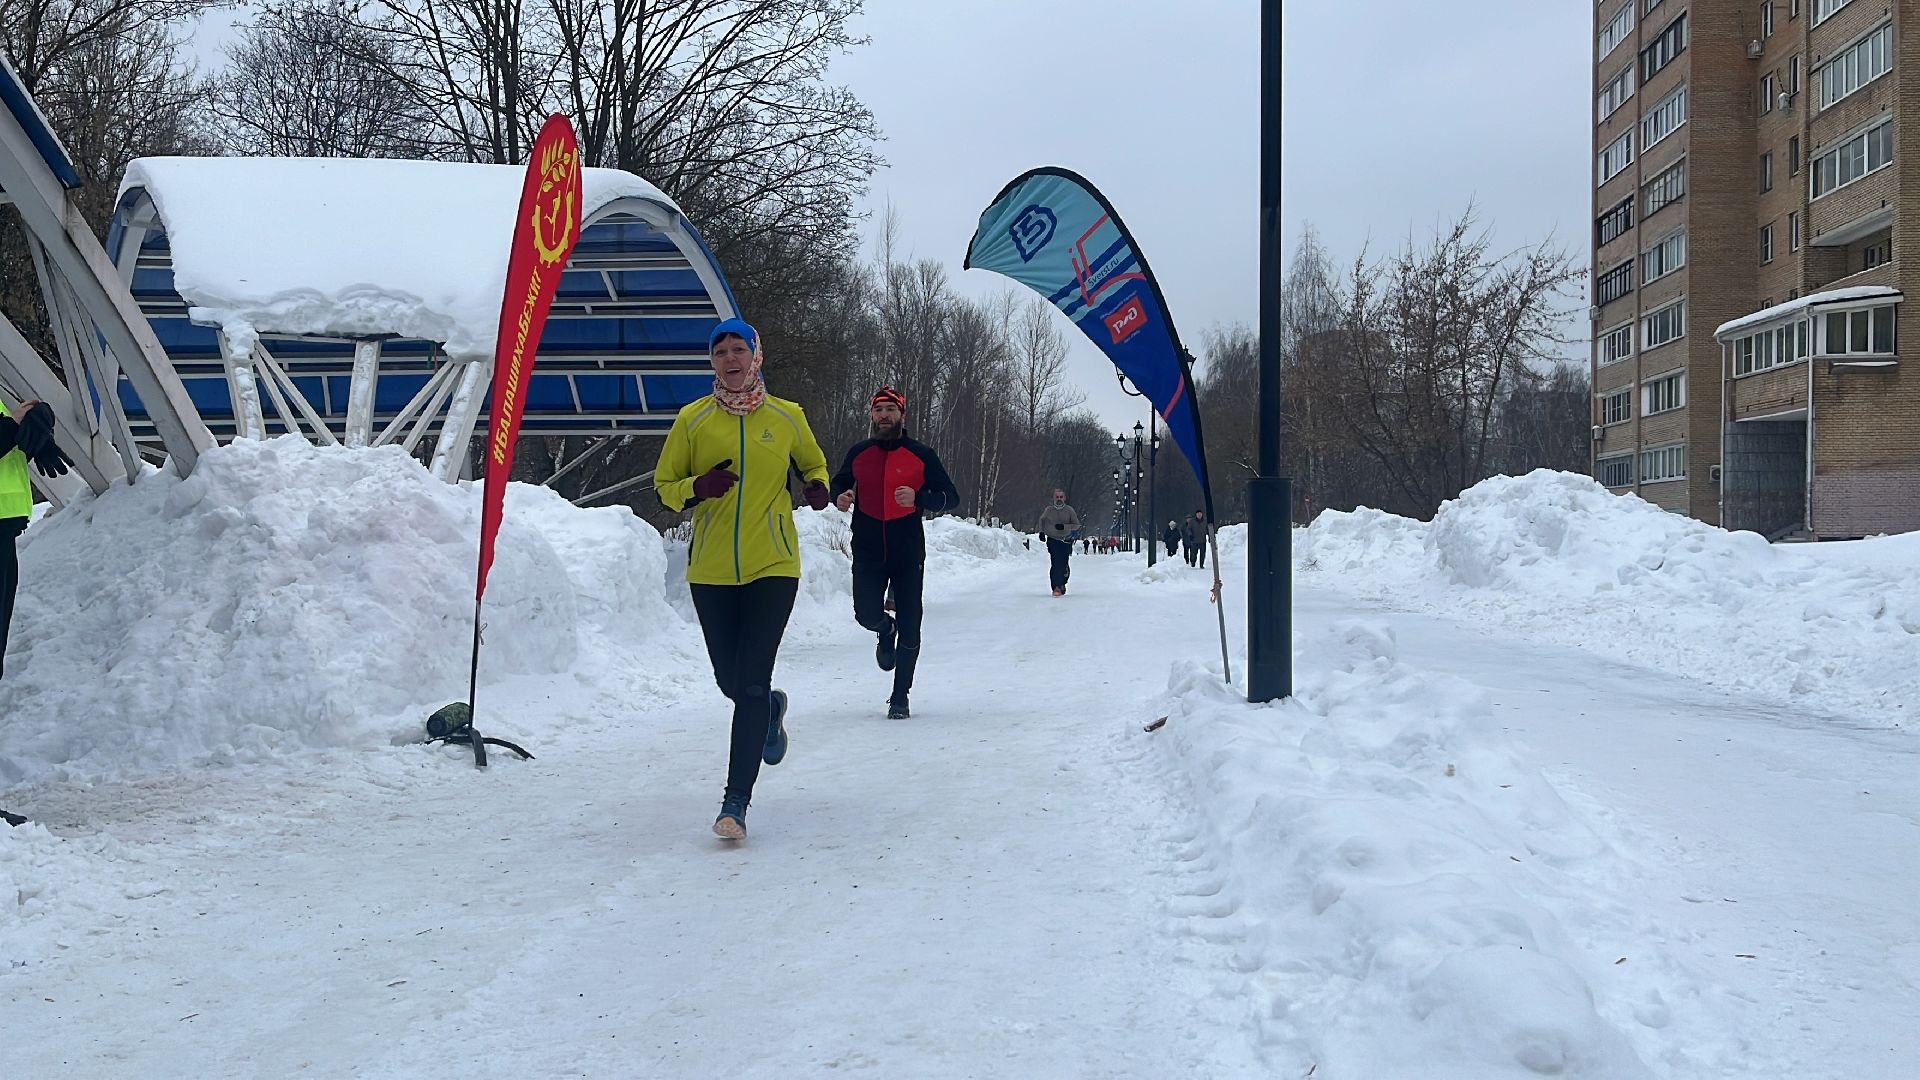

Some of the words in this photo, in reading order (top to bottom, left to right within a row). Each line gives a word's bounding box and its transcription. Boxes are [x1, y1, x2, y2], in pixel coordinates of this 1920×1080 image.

[1018, 215, 1047, 245] 5
[1087, 258, 1120, 287] 5verst.ru
[494, 266, 542, 465] #БАЛАШИХАБЕЖИТ
